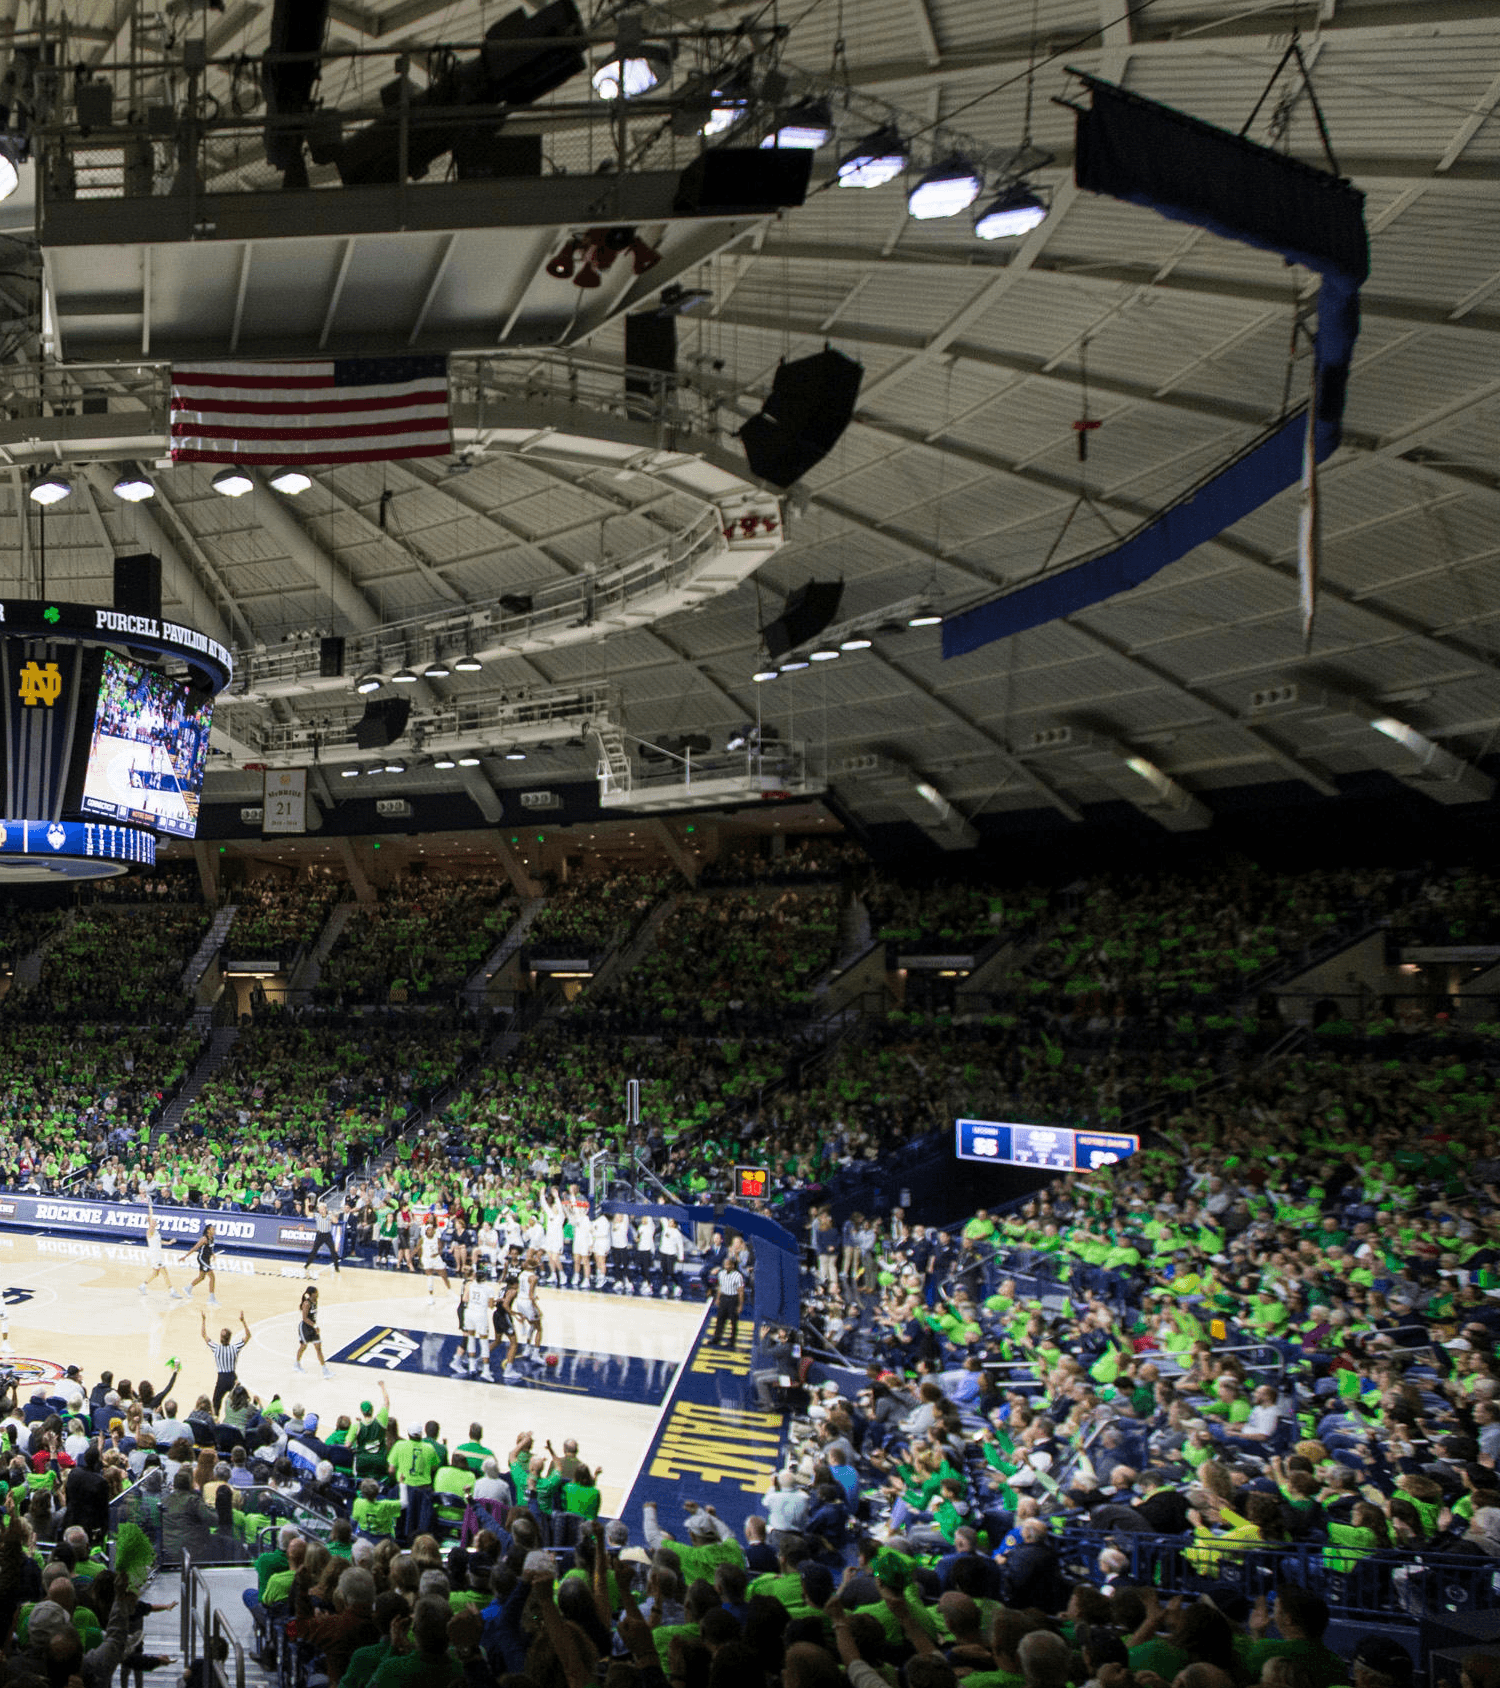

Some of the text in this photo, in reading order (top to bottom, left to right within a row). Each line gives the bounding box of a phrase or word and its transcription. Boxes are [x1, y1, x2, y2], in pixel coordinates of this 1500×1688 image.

[95, 610, 161, 639] PURCELL
[162, 622, 209, 653] PAVILION
[209, 638, 220, 658] AT
[276, 801, 292, 816] 21
[973, 1137, 999, 1156] 55
[35, 1203, 103, 1223] ROCKNE
[103, 1209, 202, 1233] ATHLETICS
[359, 1330, 420, 1369] ACC
[649, 1401, 784, 1494] DAME
